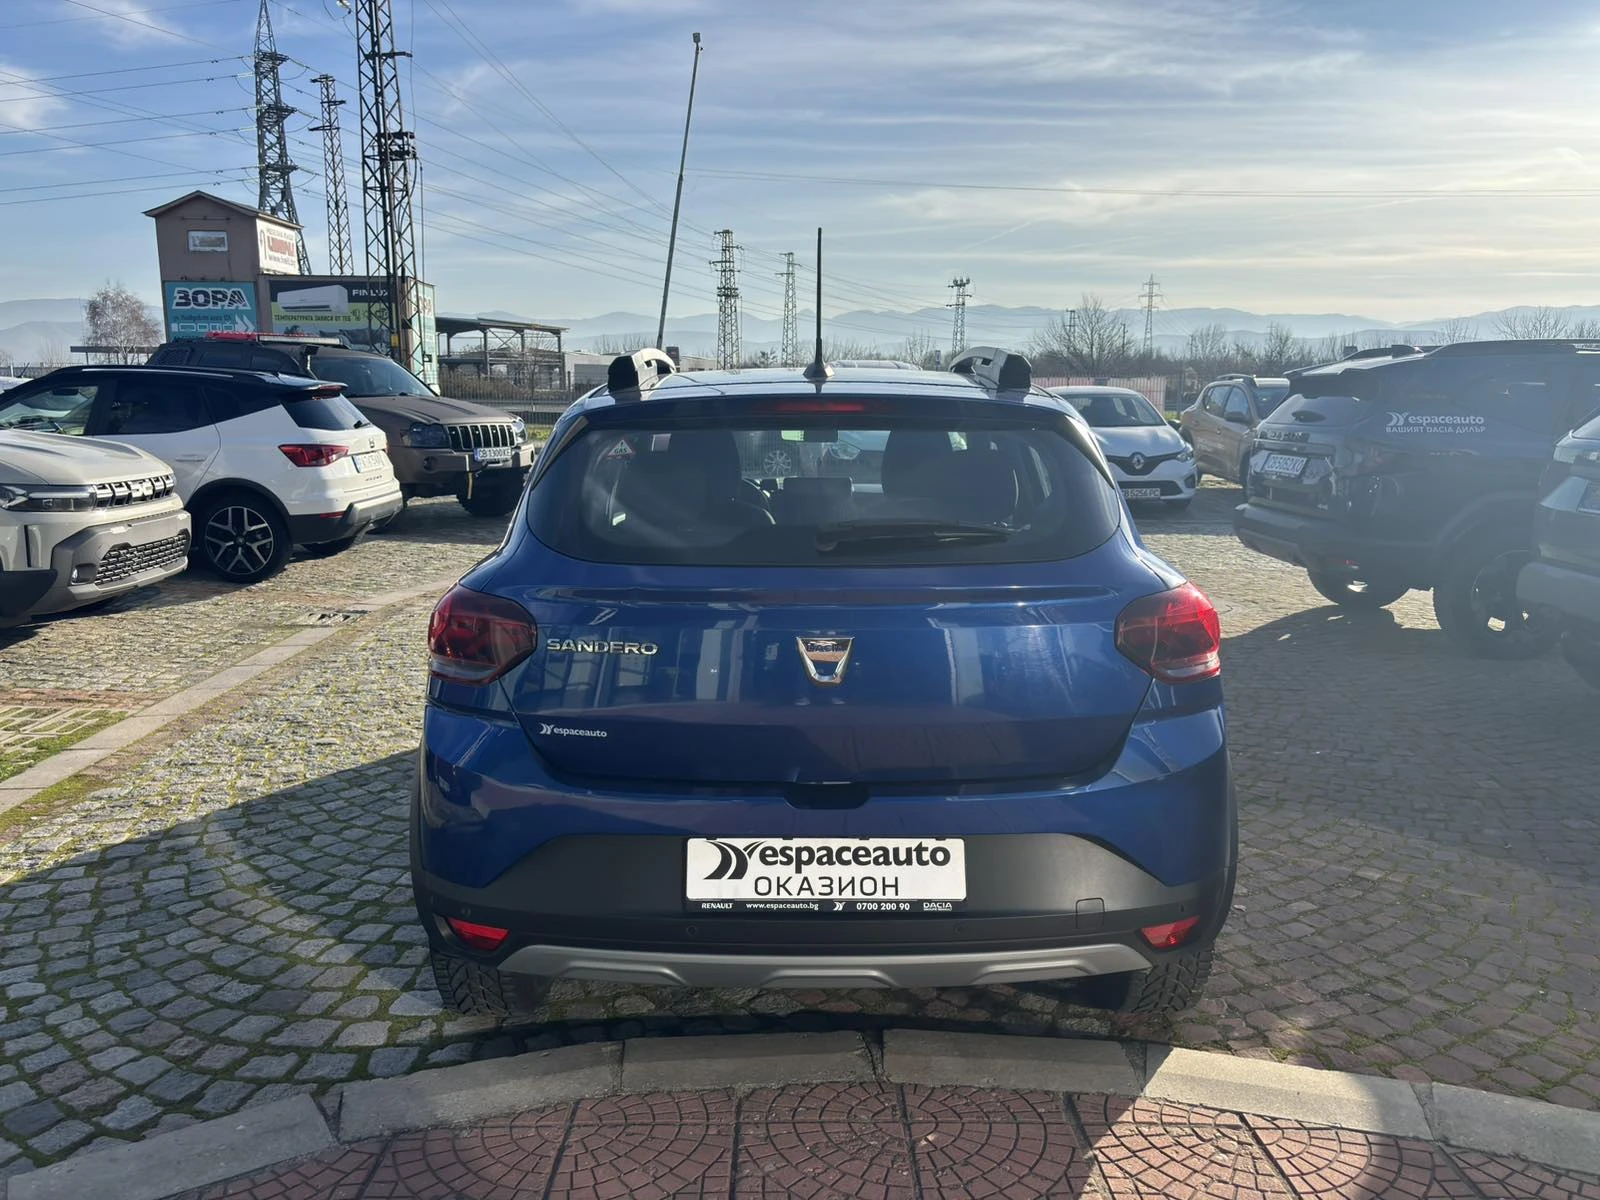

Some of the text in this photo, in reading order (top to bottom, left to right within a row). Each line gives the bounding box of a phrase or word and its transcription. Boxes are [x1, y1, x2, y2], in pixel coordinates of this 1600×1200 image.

[172, 287, 251, 309] ЗОРА
[1408, 415, 1485, 427] espaceauto
[1455, 426, 1487, 434] ДИЛЪР
[547, 638, 658, 656] SANDERO
[553, 726, 608, 738] espaceauto
[758, 841, 951, 874] espaceauto
[754, 876, 899, 897] ОКАЗИОН
[701, 902, 733, 910] RENAULT
[746, 902, 819, 911] www.espaceauto.bg
[856, 902, 878, 911] 0700
[880, 902, 897, 911] 200
[899, 902, 911, 911] 90
